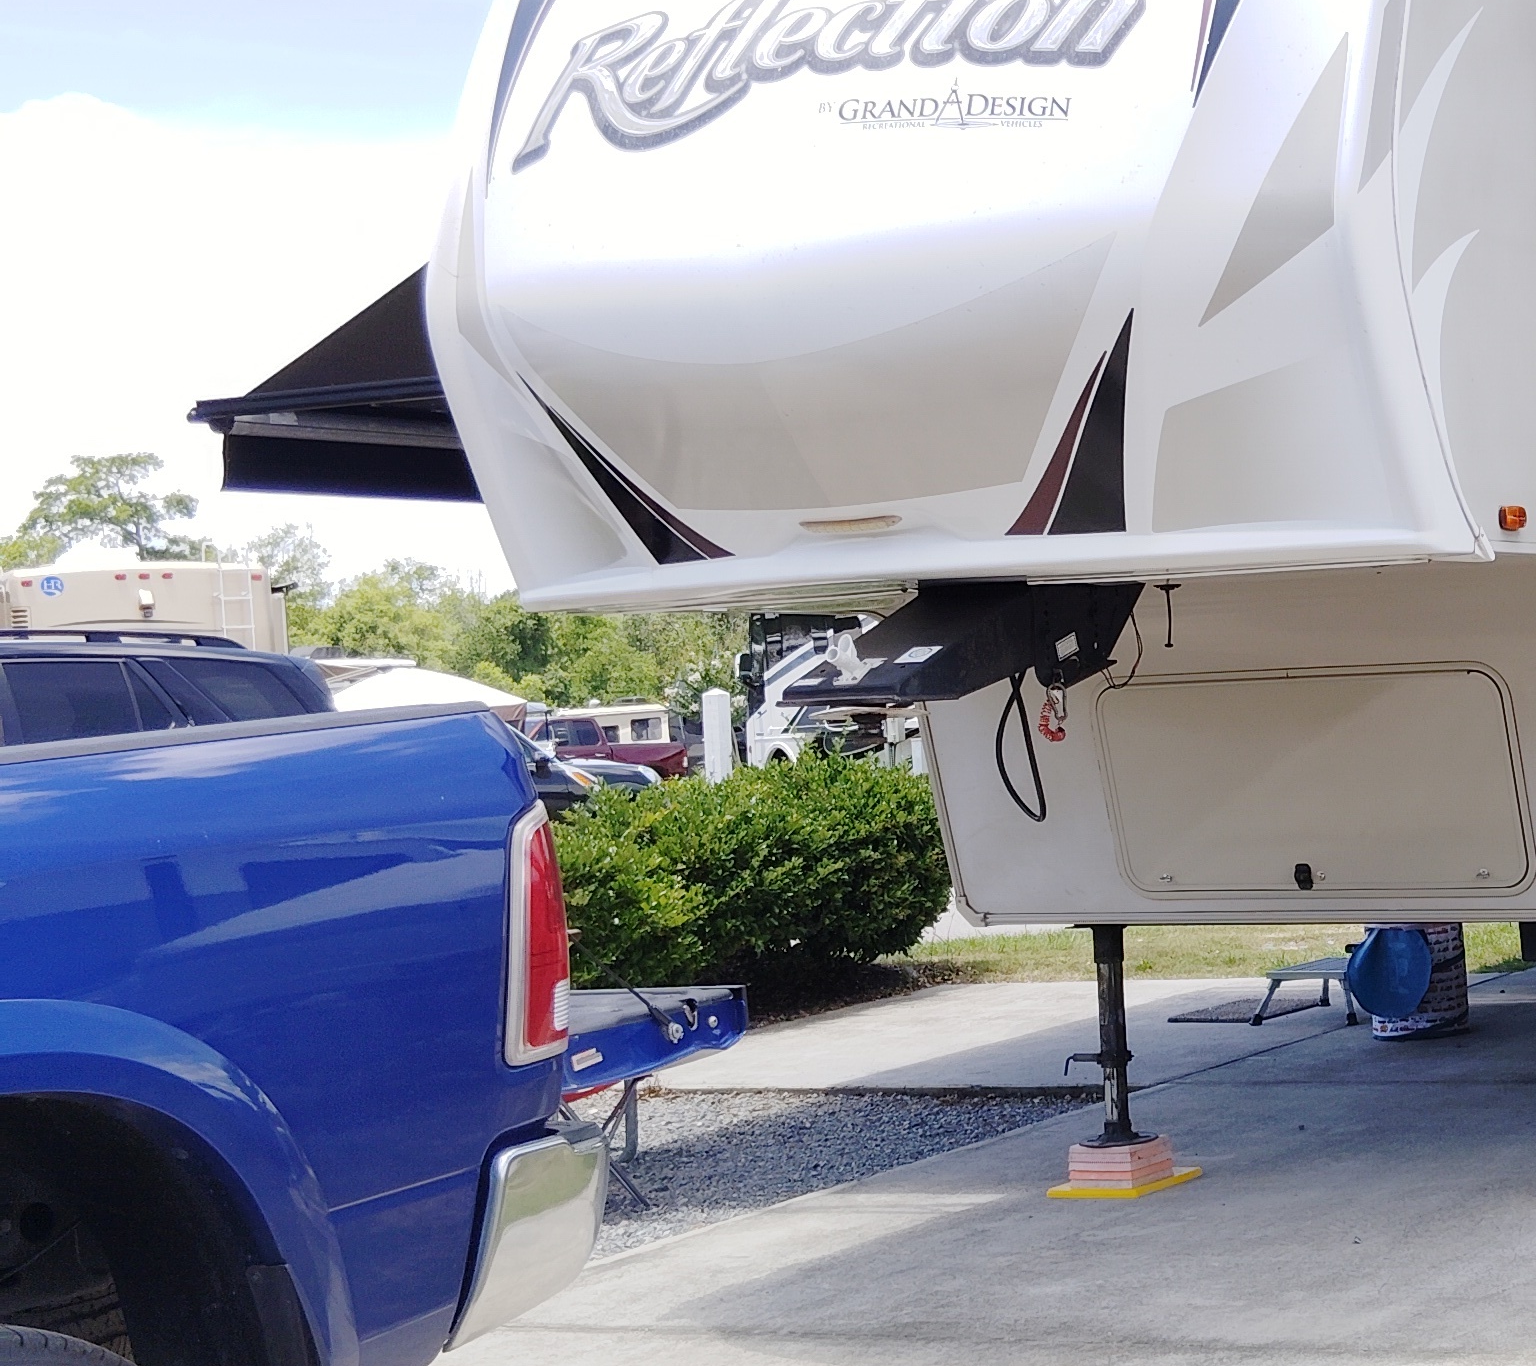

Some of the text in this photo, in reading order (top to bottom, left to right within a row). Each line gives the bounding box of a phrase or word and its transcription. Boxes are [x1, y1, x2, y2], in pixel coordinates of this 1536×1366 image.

[818, 93, 1072, 122] BY GRAND DESIGN
[1000, 120, 1043, 128] VEHICLES
